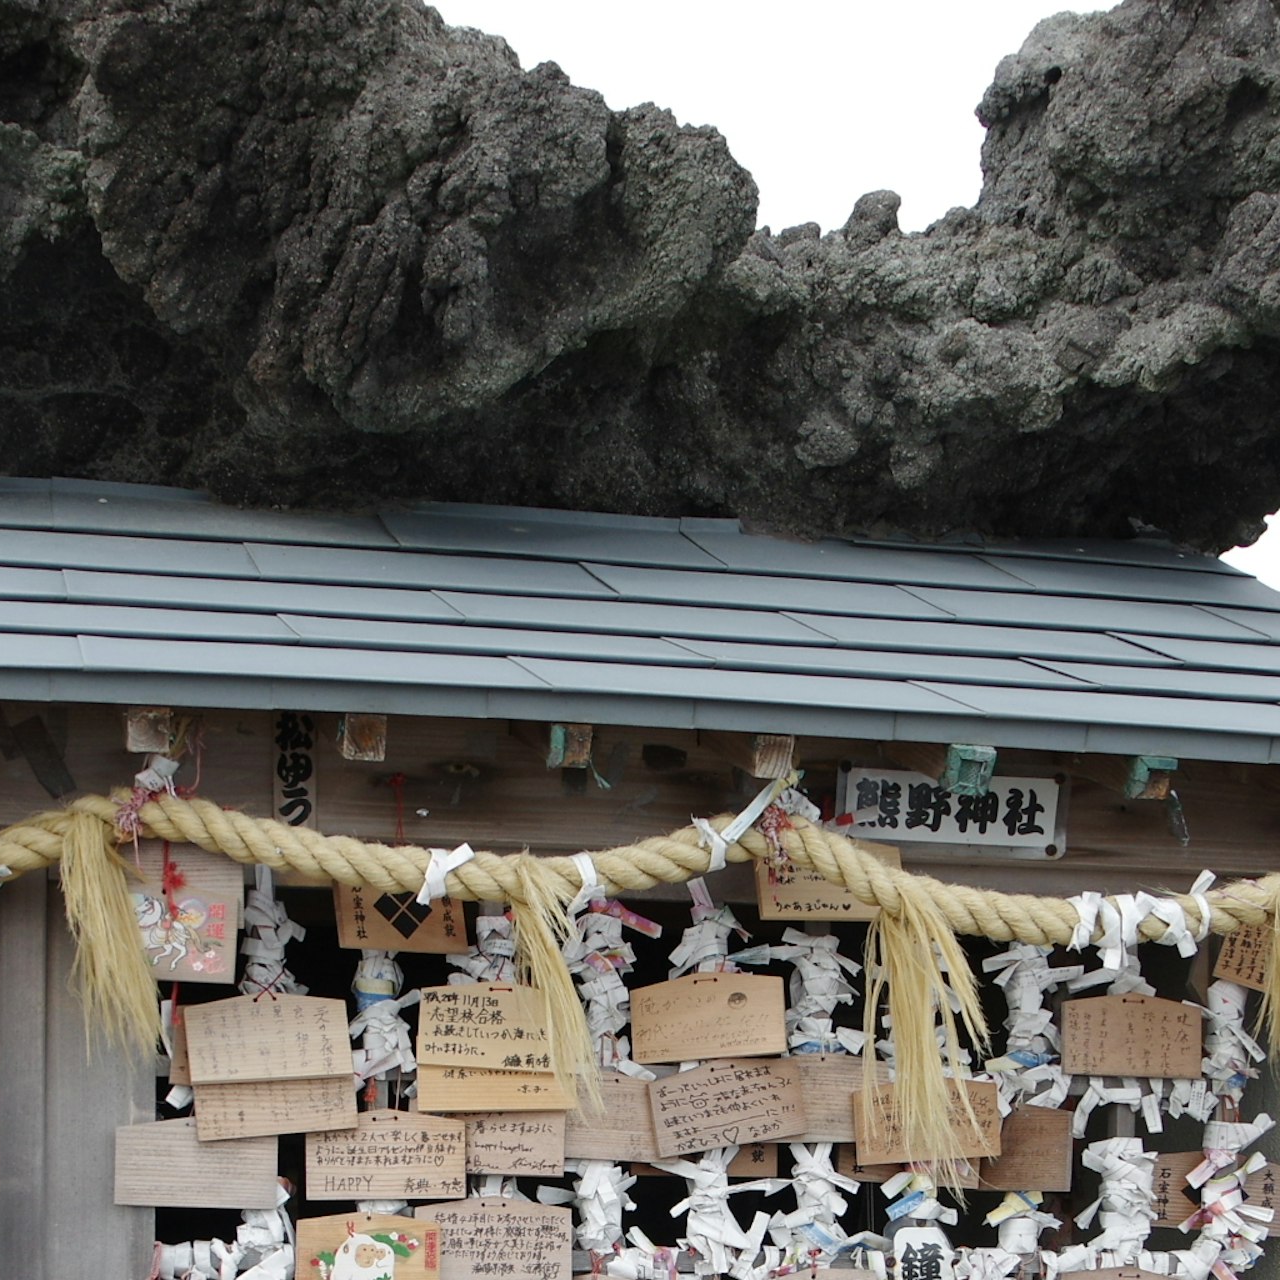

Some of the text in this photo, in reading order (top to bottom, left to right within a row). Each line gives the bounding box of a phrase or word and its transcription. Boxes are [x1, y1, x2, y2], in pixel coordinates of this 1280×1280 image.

[855, 777, 1045, 836] 熊野神社
[324, 1175, 374, 1192] HAPPY
